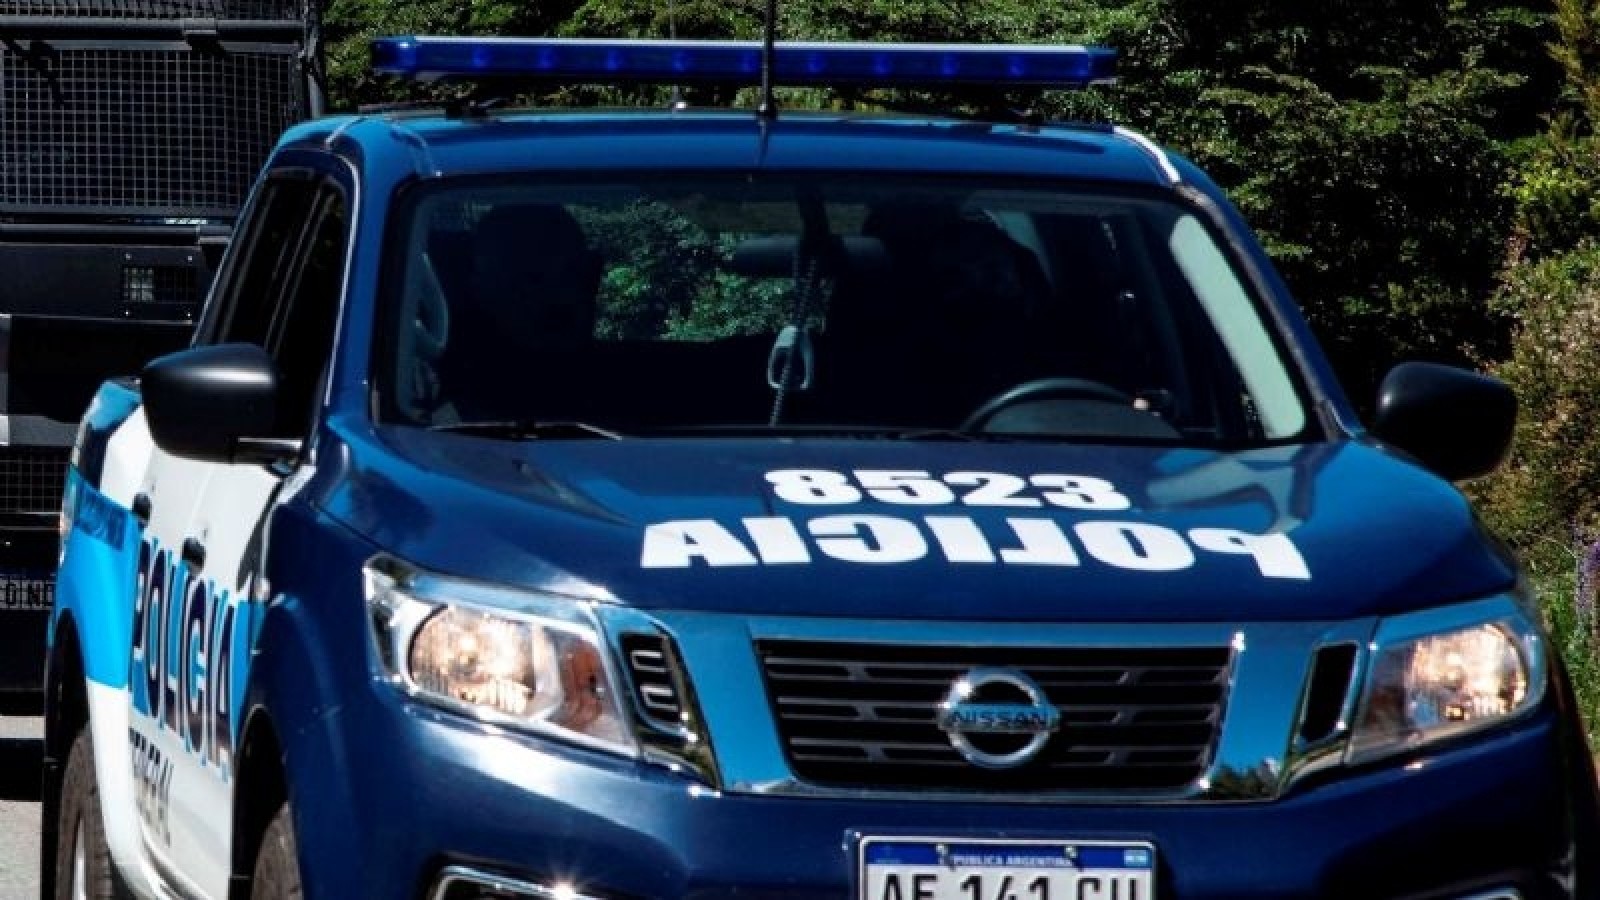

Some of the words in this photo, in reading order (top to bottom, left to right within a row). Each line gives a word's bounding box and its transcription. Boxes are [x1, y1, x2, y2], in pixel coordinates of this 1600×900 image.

[764, 469, 1132, 511] 8523
[129, 536, 234, 783] POLICIA
[951, 710, 1049, 728] NISSAN
